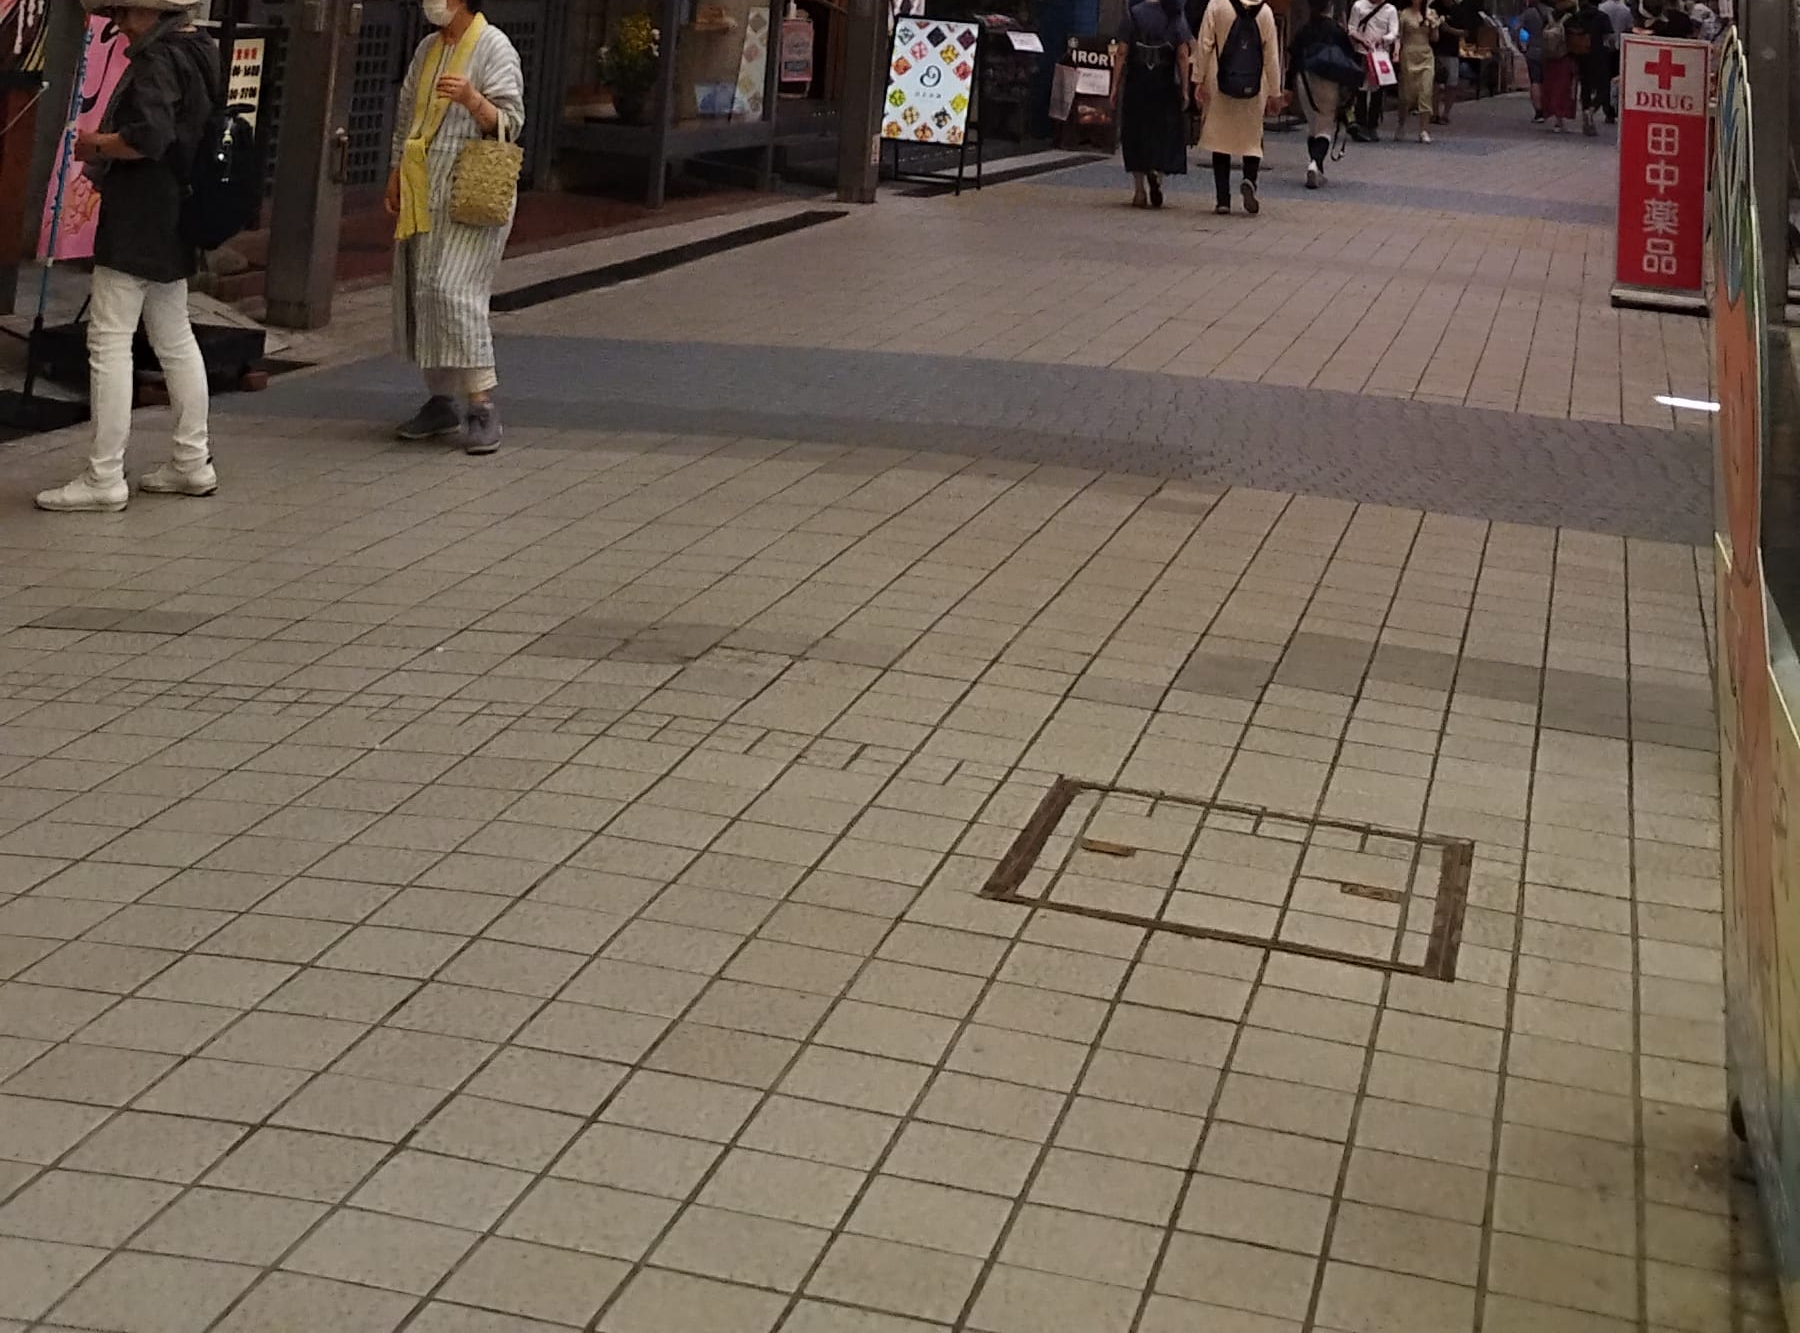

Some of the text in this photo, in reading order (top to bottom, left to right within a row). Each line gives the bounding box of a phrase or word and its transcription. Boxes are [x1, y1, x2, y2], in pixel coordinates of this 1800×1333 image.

[1635, 90, 1695, 112] DRUG
[1642, 122, 1680, 276] 田中薬品
